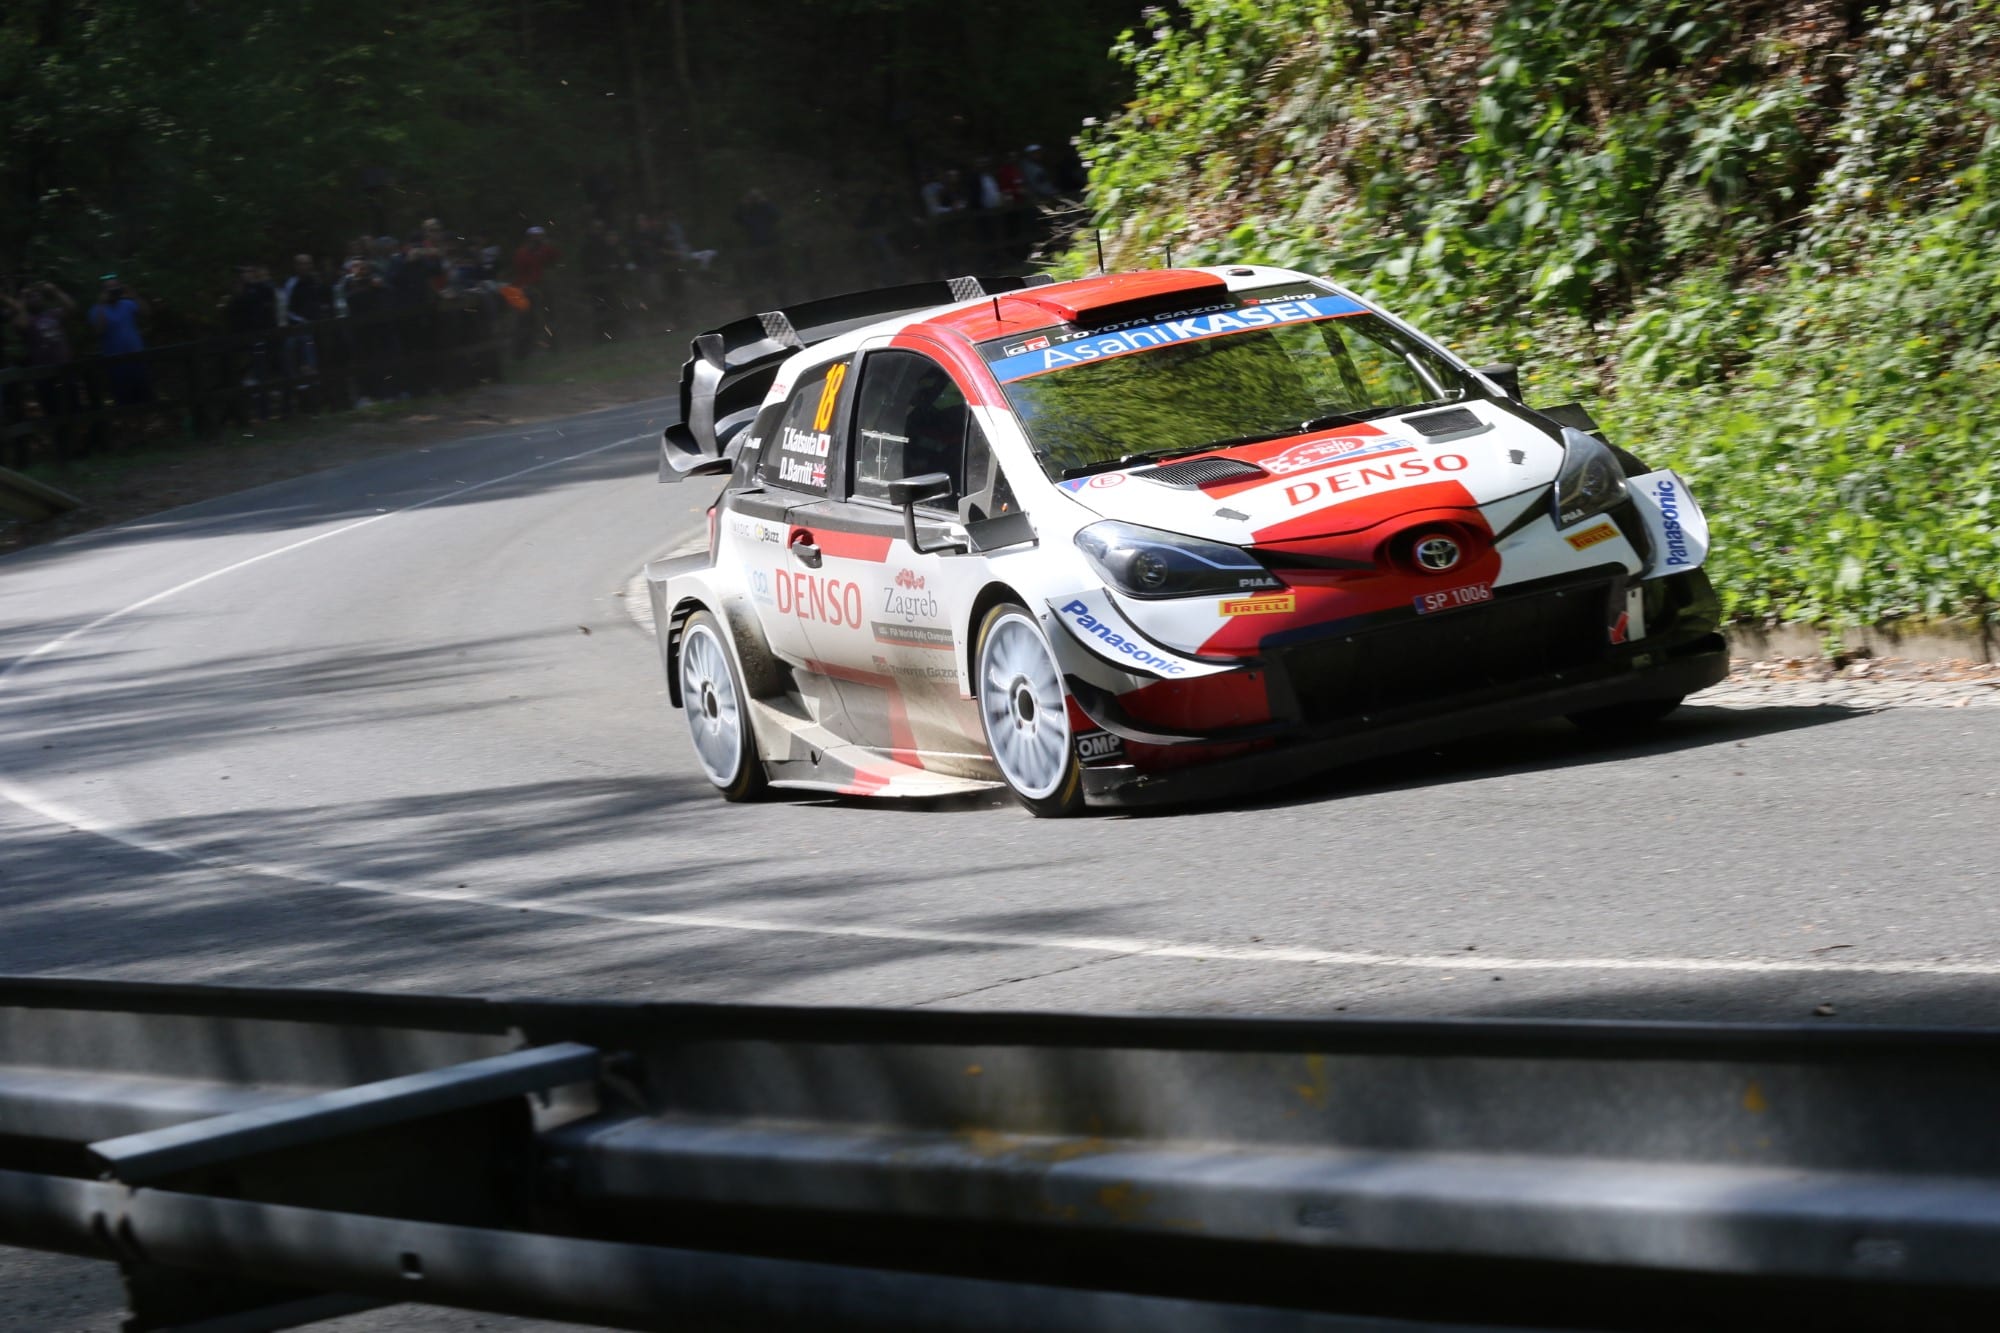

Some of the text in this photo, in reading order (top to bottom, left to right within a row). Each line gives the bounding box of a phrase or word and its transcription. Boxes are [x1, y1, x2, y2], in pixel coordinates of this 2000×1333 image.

[1007, 292, 1317, 356] GR TOYOTA GAZOO Racing
[813, 363, 846, 432] 18
[782, 426, 818, 456] T.Katsuta
[779, 456, 813, 486] D.Barritt
[1283, 454, 1469, 507] DENSO
[1653, 480, 1690, 566] Panasonic
[775, 568, 862, 630] DENSO
[1239, 577, 1279, 588] PIAA
[1425, 585, 1489, 610] SP 1006
[883, 586, 938, 623] Zagreb
[1223, 597, 1289, 614] PIRELLI
[1060, 599, 1186, 675] Panasonic
[1078, 734, 1120, 756] OMP
